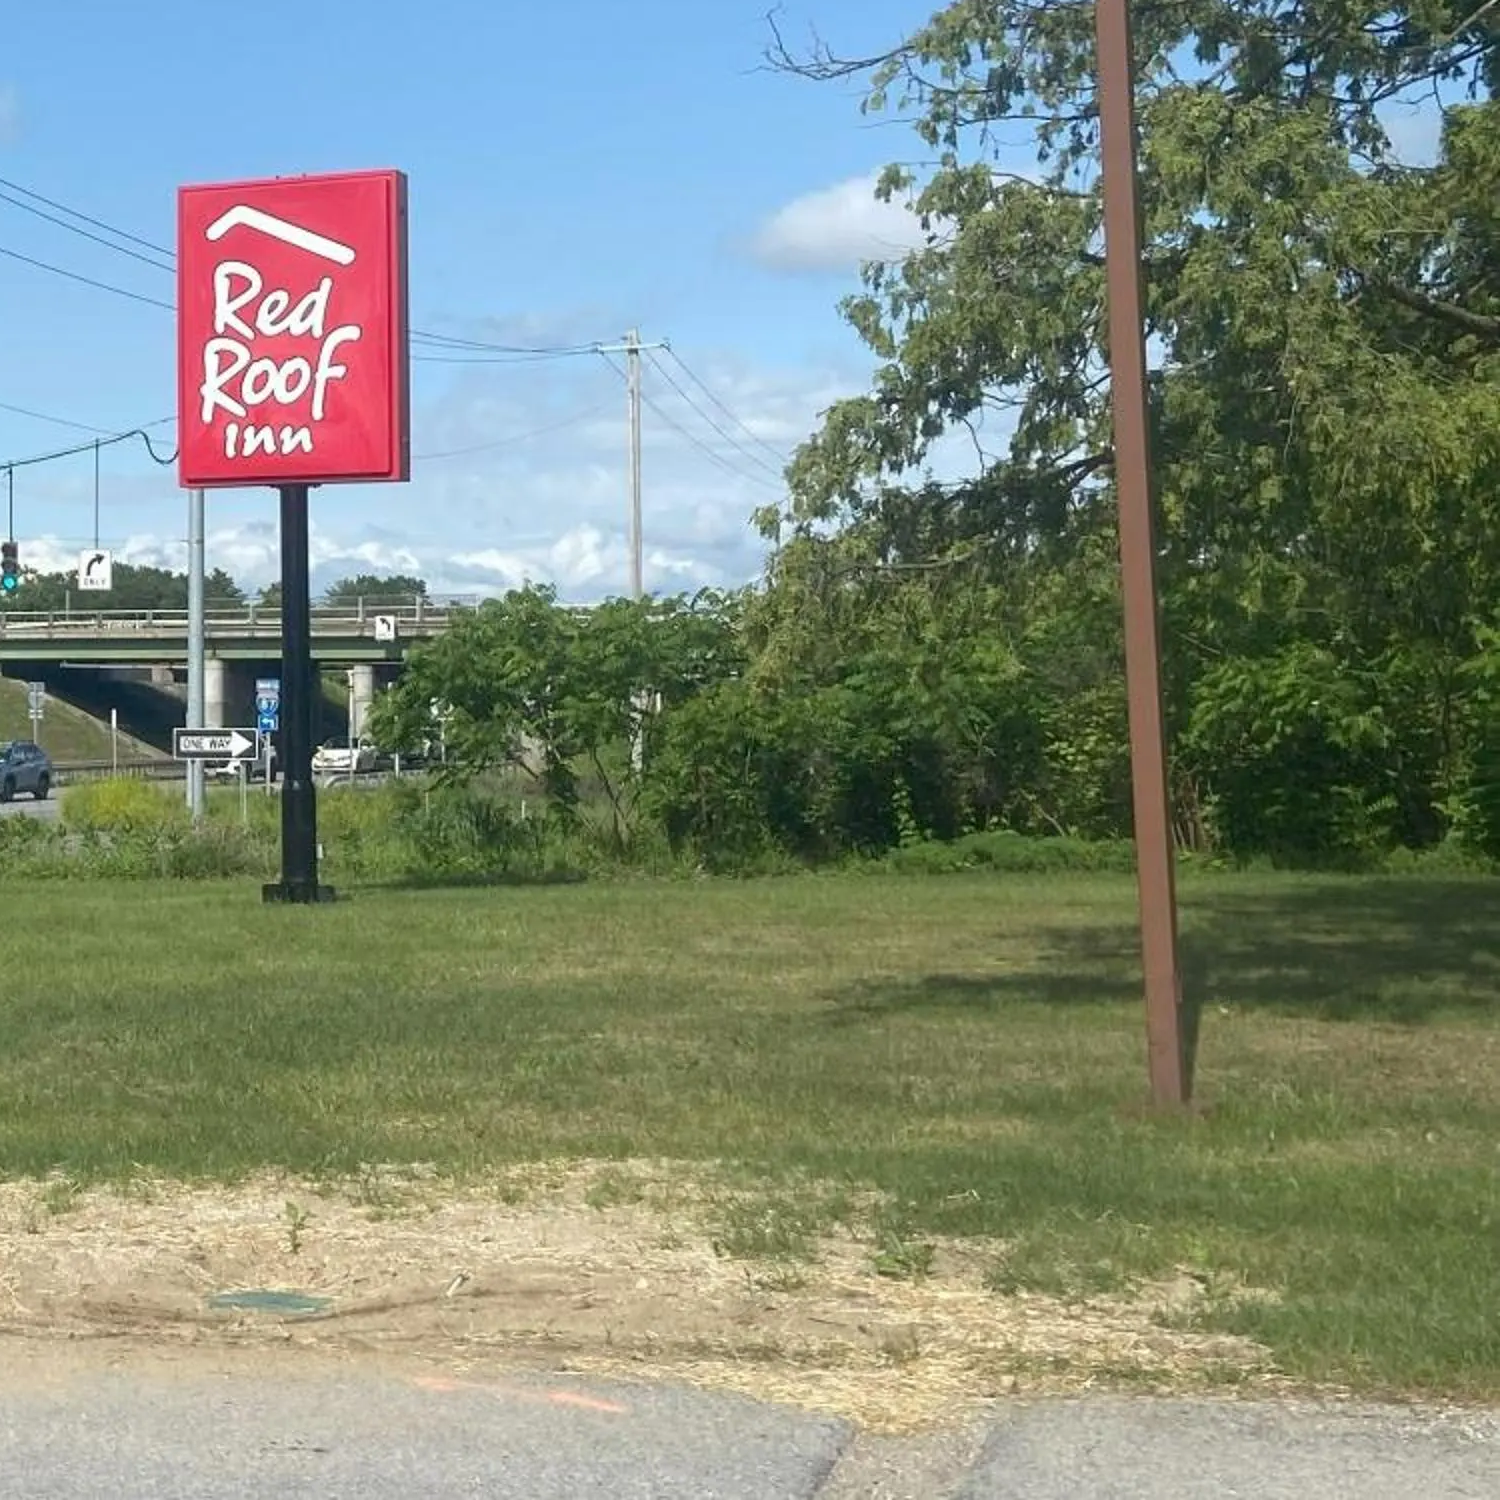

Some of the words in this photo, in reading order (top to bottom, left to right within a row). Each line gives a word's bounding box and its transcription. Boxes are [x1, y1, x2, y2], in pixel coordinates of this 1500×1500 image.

[213, 261, 333, 340] Red
[200, 325, 362, 423] Roof
[183, 737, 204, 749] ONE
[209, 737, 231, 749] WAY
